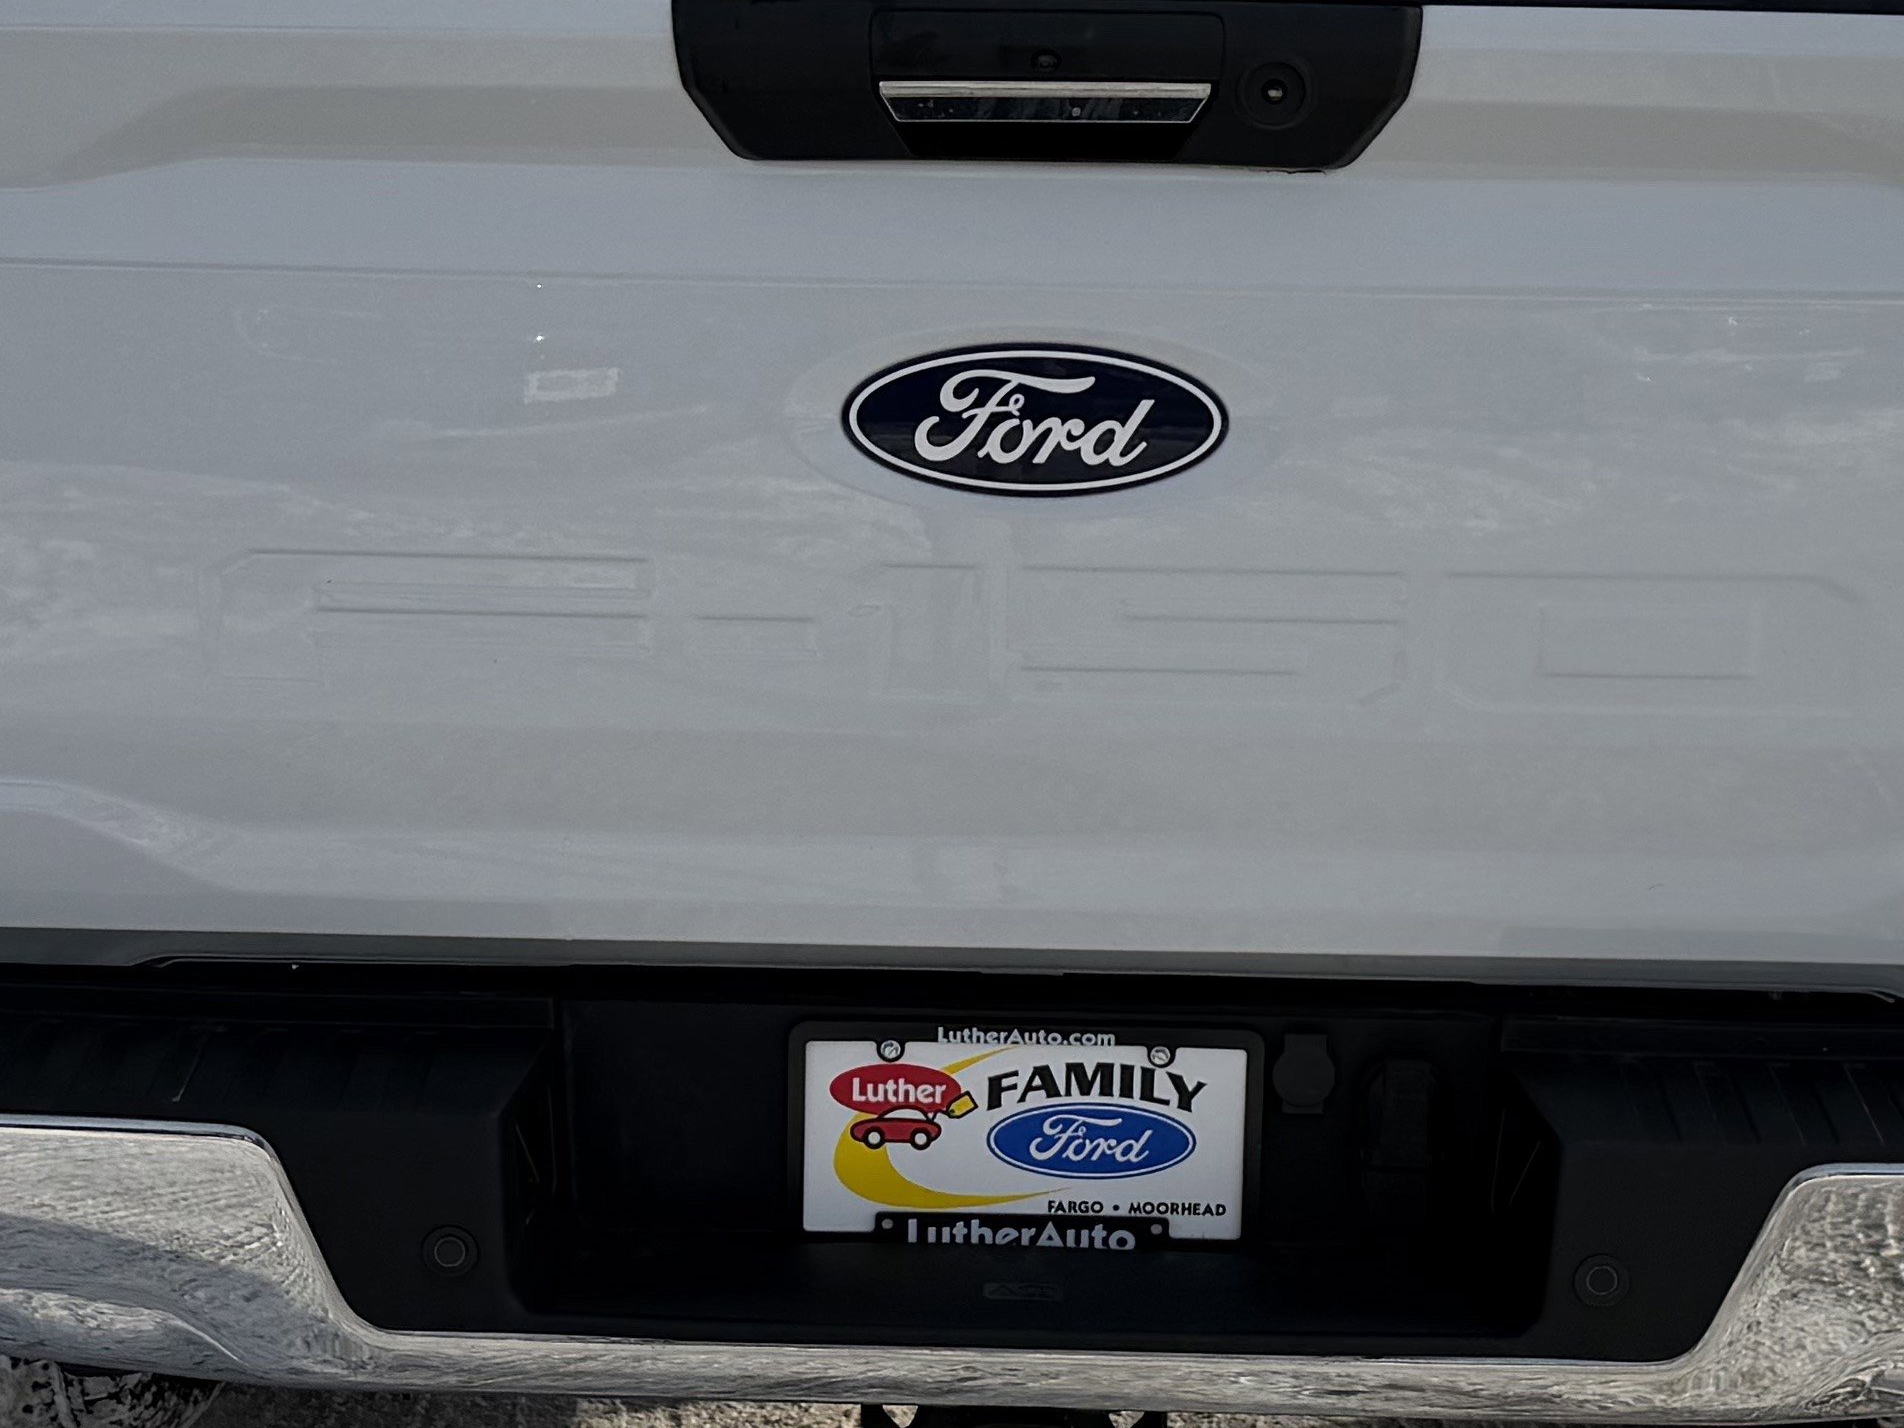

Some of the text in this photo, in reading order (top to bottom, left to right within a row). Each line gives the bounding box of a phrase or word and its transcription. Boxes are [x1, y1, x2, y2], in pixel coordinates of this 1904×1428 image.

[914, 368, 1156, 468] Ford
[937, 1026, 1116, 1047] LutherAuto.com
[852, 1076, 947, 1105] Luther
[986, 1061, 1208, 1114] FAMILY
[1028, 1113, 1152, 1164] Ford
[1047, 1199, 1227, 1217] FARGO MOORHEAD
